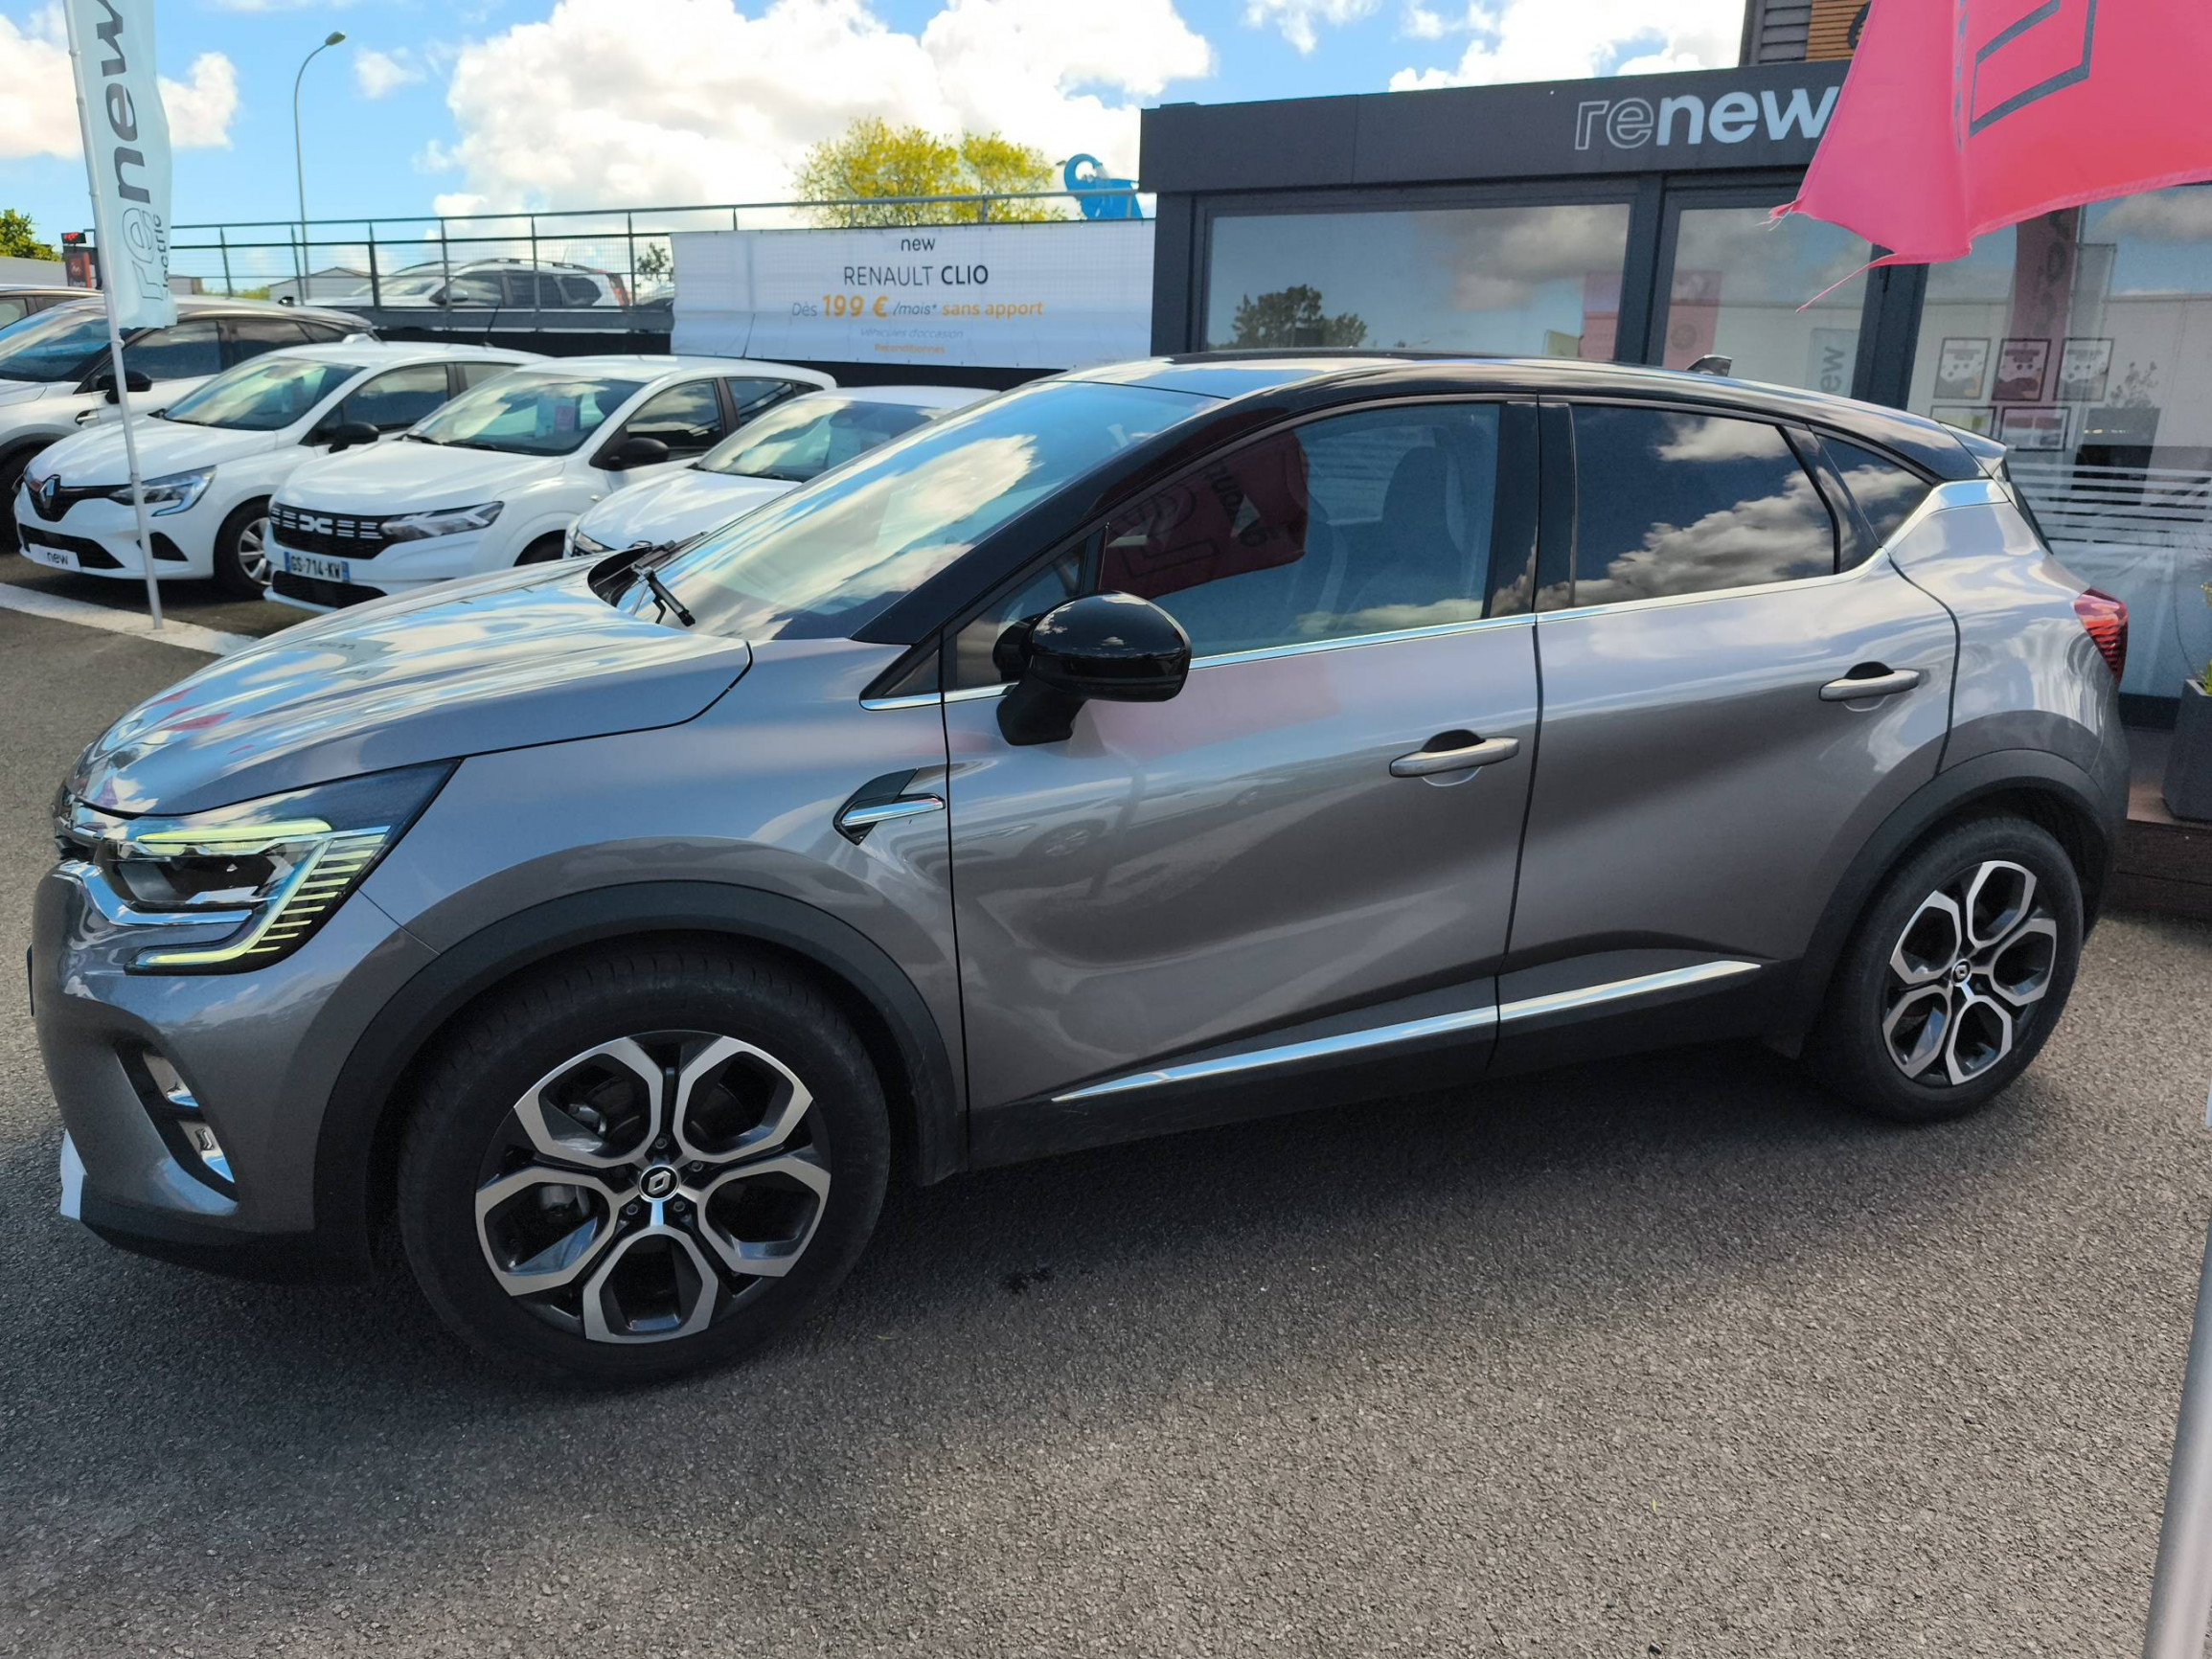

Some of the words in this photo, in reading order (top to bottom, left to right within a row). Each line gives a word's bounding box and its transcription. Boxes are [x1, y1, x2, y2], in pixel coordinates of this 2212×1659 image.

[1574, 85, 1840, 150] renew
[901, 239, 936, 252] new
[844, 266, 933, 286] RENAULT
[941, 264, 989, 285] CLIO
[791, 302, 818, 317] Dès
[822, 294, 864, 317] 199
[942, 303, 981, 316] sans
[985, 301, 1043, 319] apport
[46, 552, 68, 565] new
